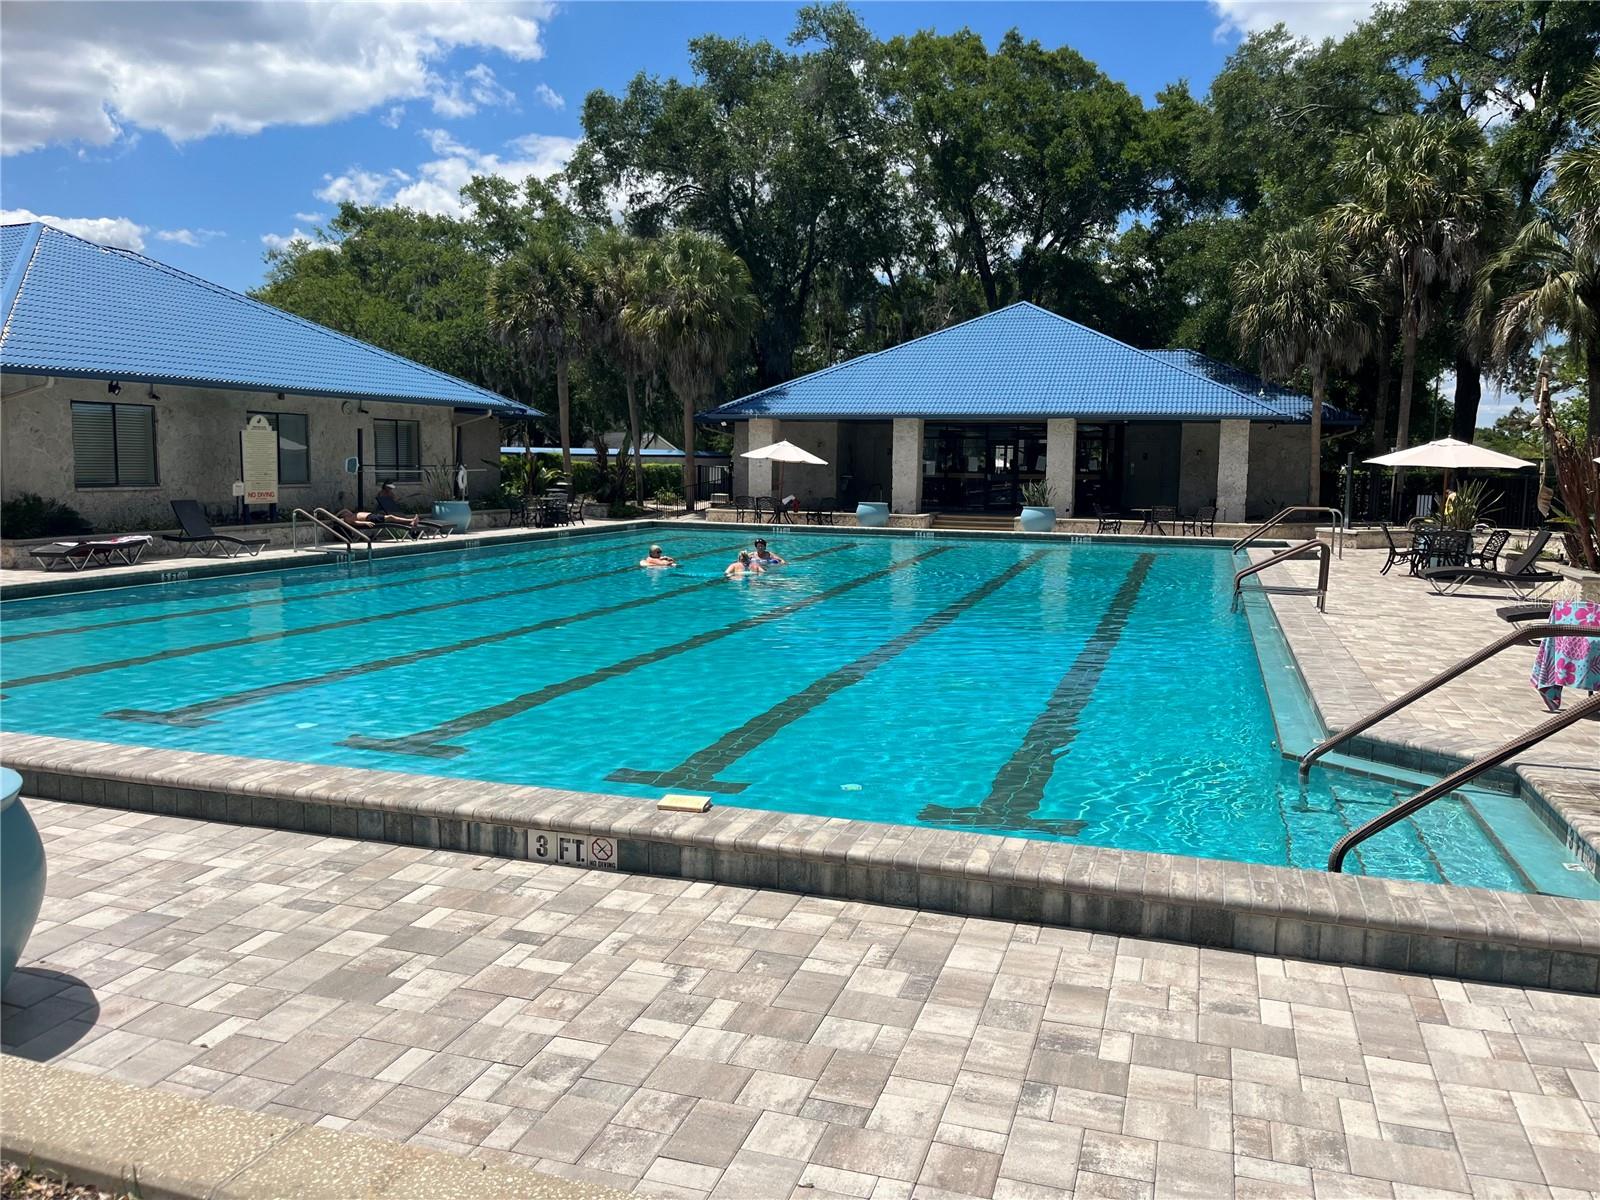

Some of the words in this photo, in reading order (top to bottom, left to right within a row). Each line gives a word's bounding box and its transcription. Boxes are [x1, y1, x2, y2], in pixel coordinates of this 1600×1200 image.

[536, 835, 548, 857] 3
[559, 837, 585, 862] FT.
[598, 861, 616, 869] DIVING
